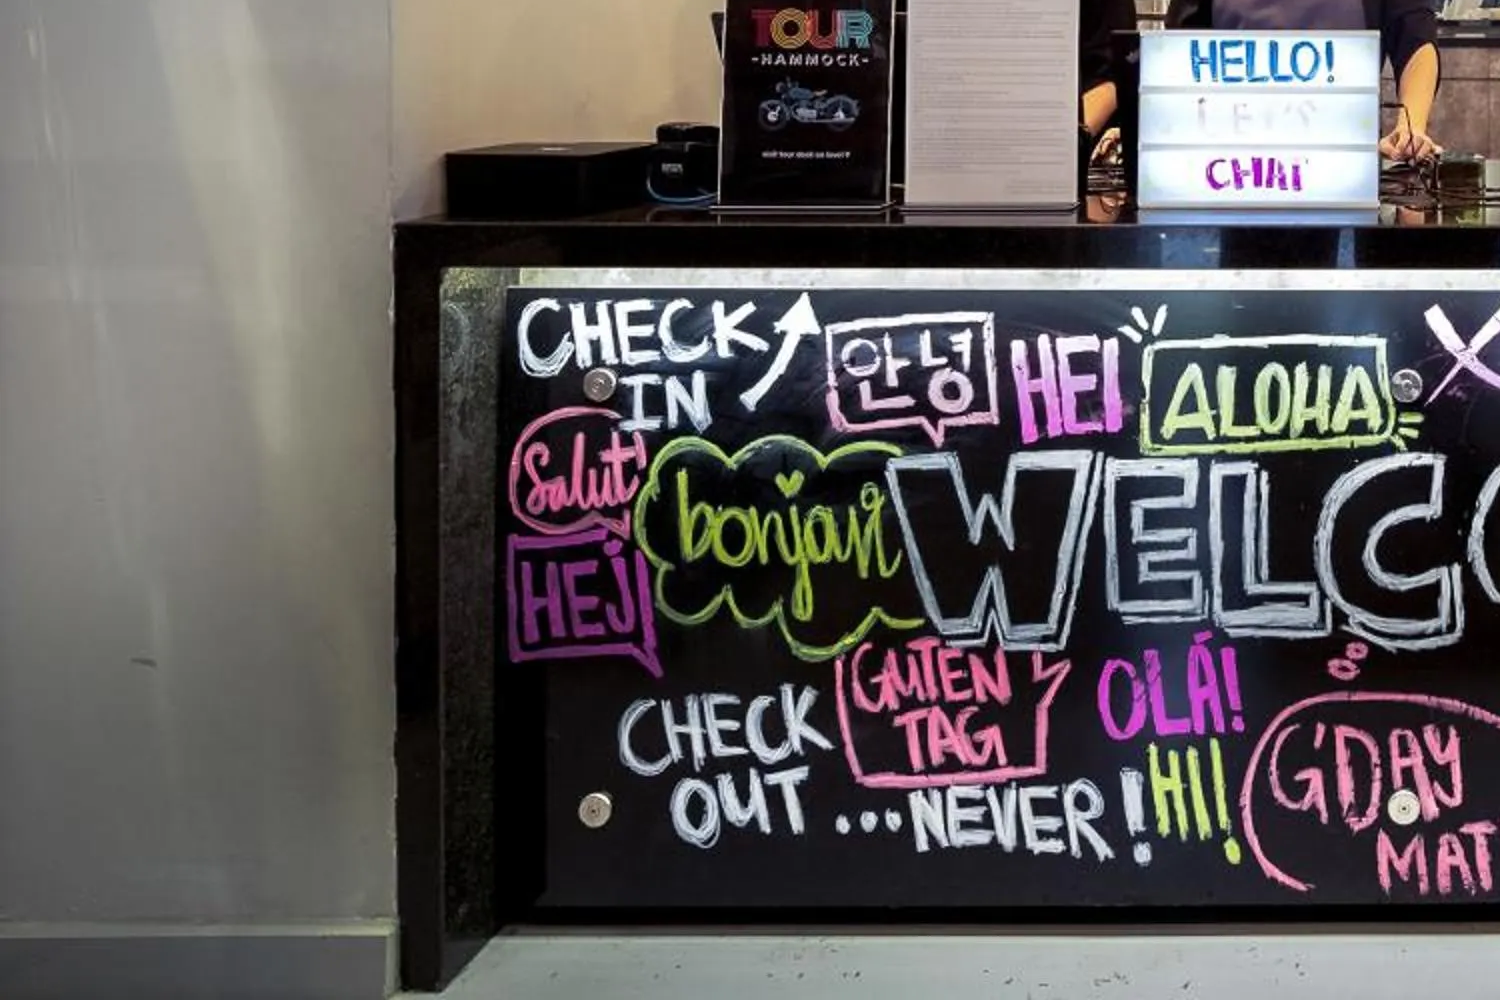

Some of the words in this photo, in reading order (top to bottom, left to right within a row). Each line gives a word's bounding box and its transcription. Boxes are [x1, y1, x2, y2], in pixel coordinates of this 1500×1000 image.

[751, 7, 874, 50] TOUR
[1189, 39, 1335, 83] HELLO!
[517, 298, 769, 377] CHECK
[841, 328, 975, 413] 안녕
[618, 369, 713, 433] IN
[1160, 361, 1384, 440] ALOHA
[521, 540, 635, 644] HEJ
[851, 637, 1012, 712] GUTEN
[1097, 631, 1245, 741] OLÁ!
[618, 683, 834, 777] CHECK
[893, 706, 1007, 772] TAG
[670, 765, 809, 848] OUT
[1148, 737, 1241, 865] HI!
[1270, 720, 1464, 832] G'DAY
